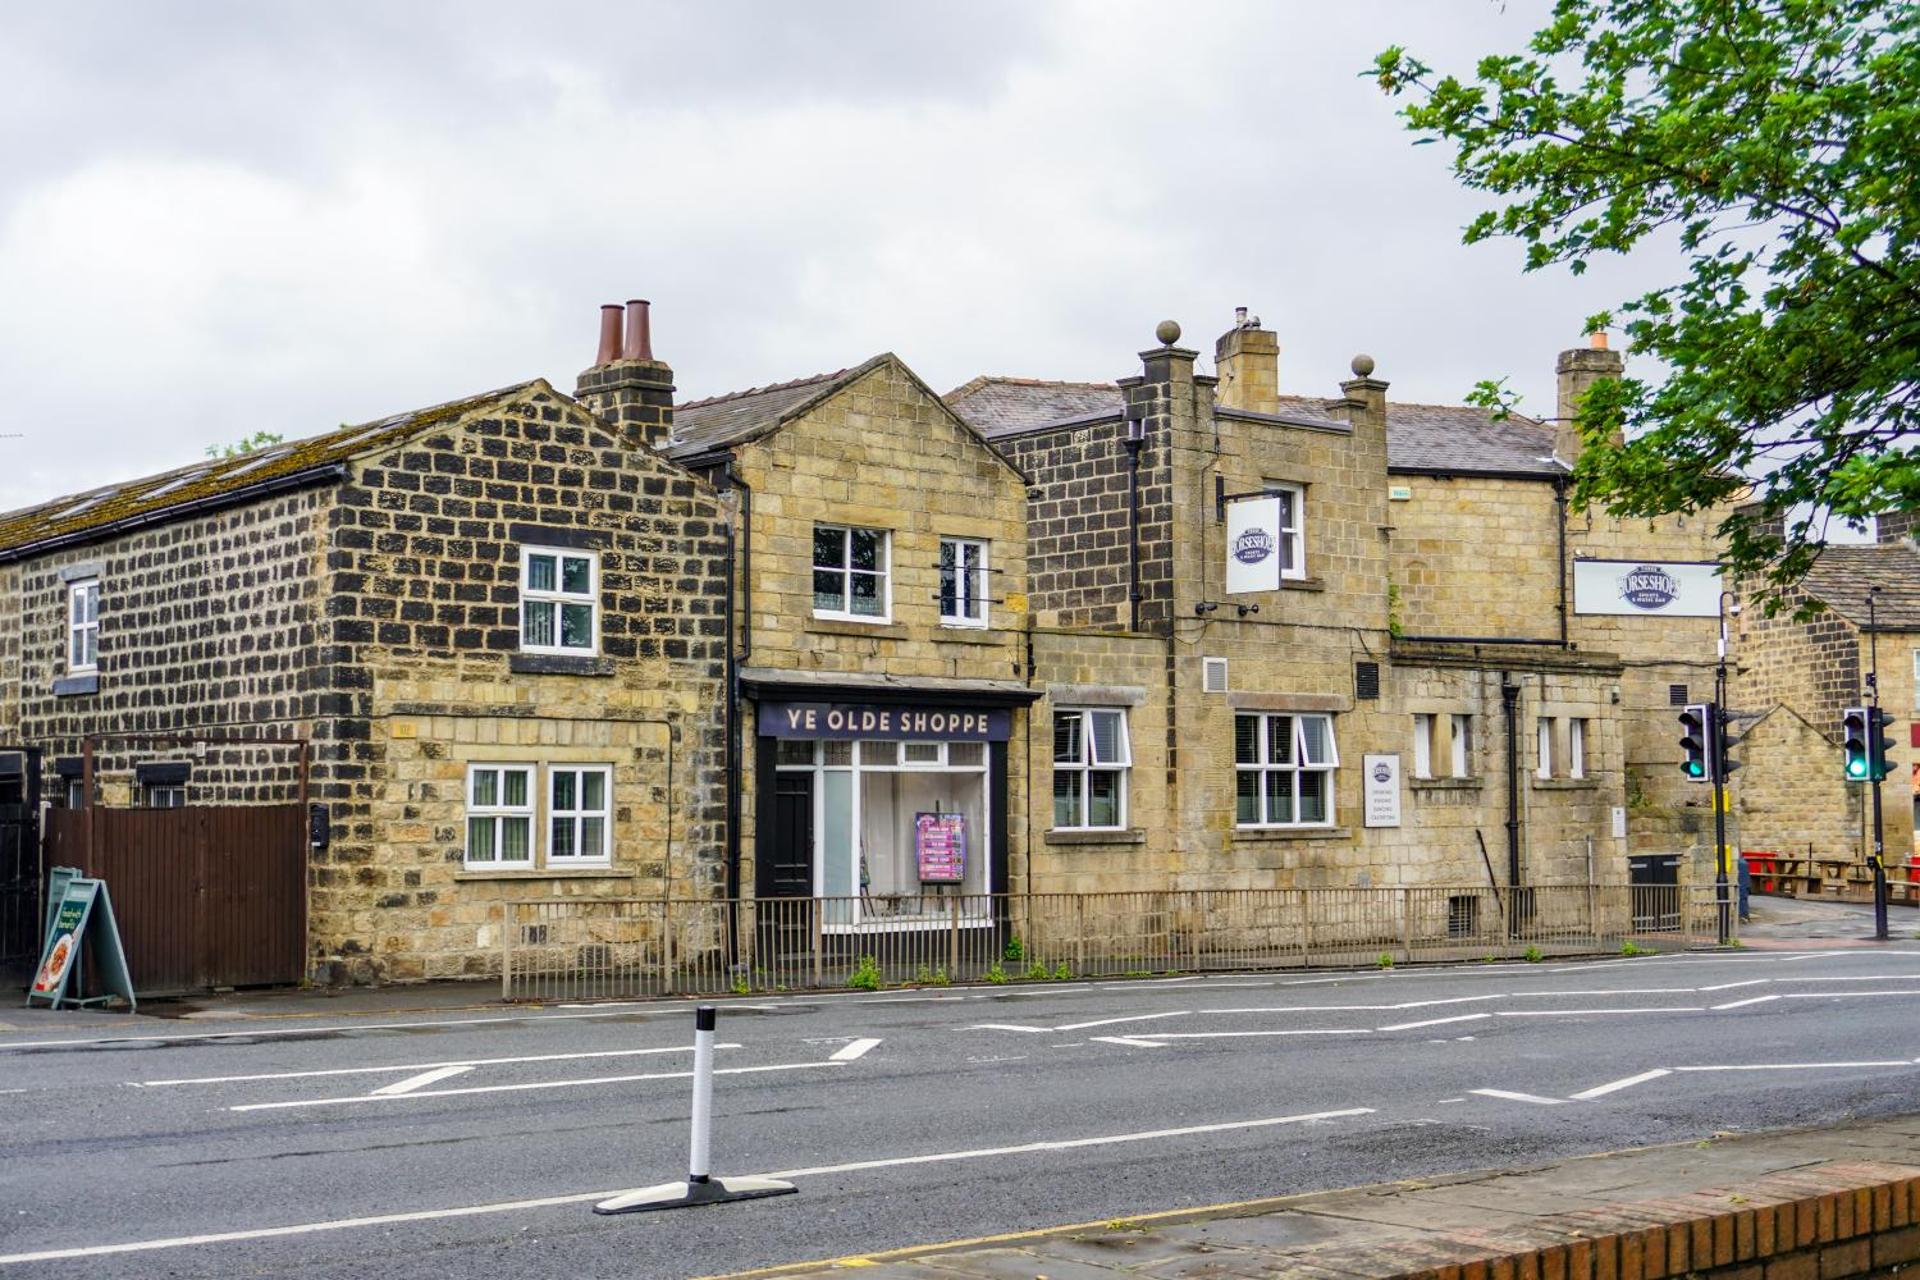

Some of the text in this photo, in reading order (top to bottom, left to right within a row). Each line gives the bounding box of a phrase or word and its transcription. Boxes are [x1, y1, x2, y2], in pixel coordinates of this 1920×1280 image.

[787, 708, 989, 733] YE OLDE SHOPPE
